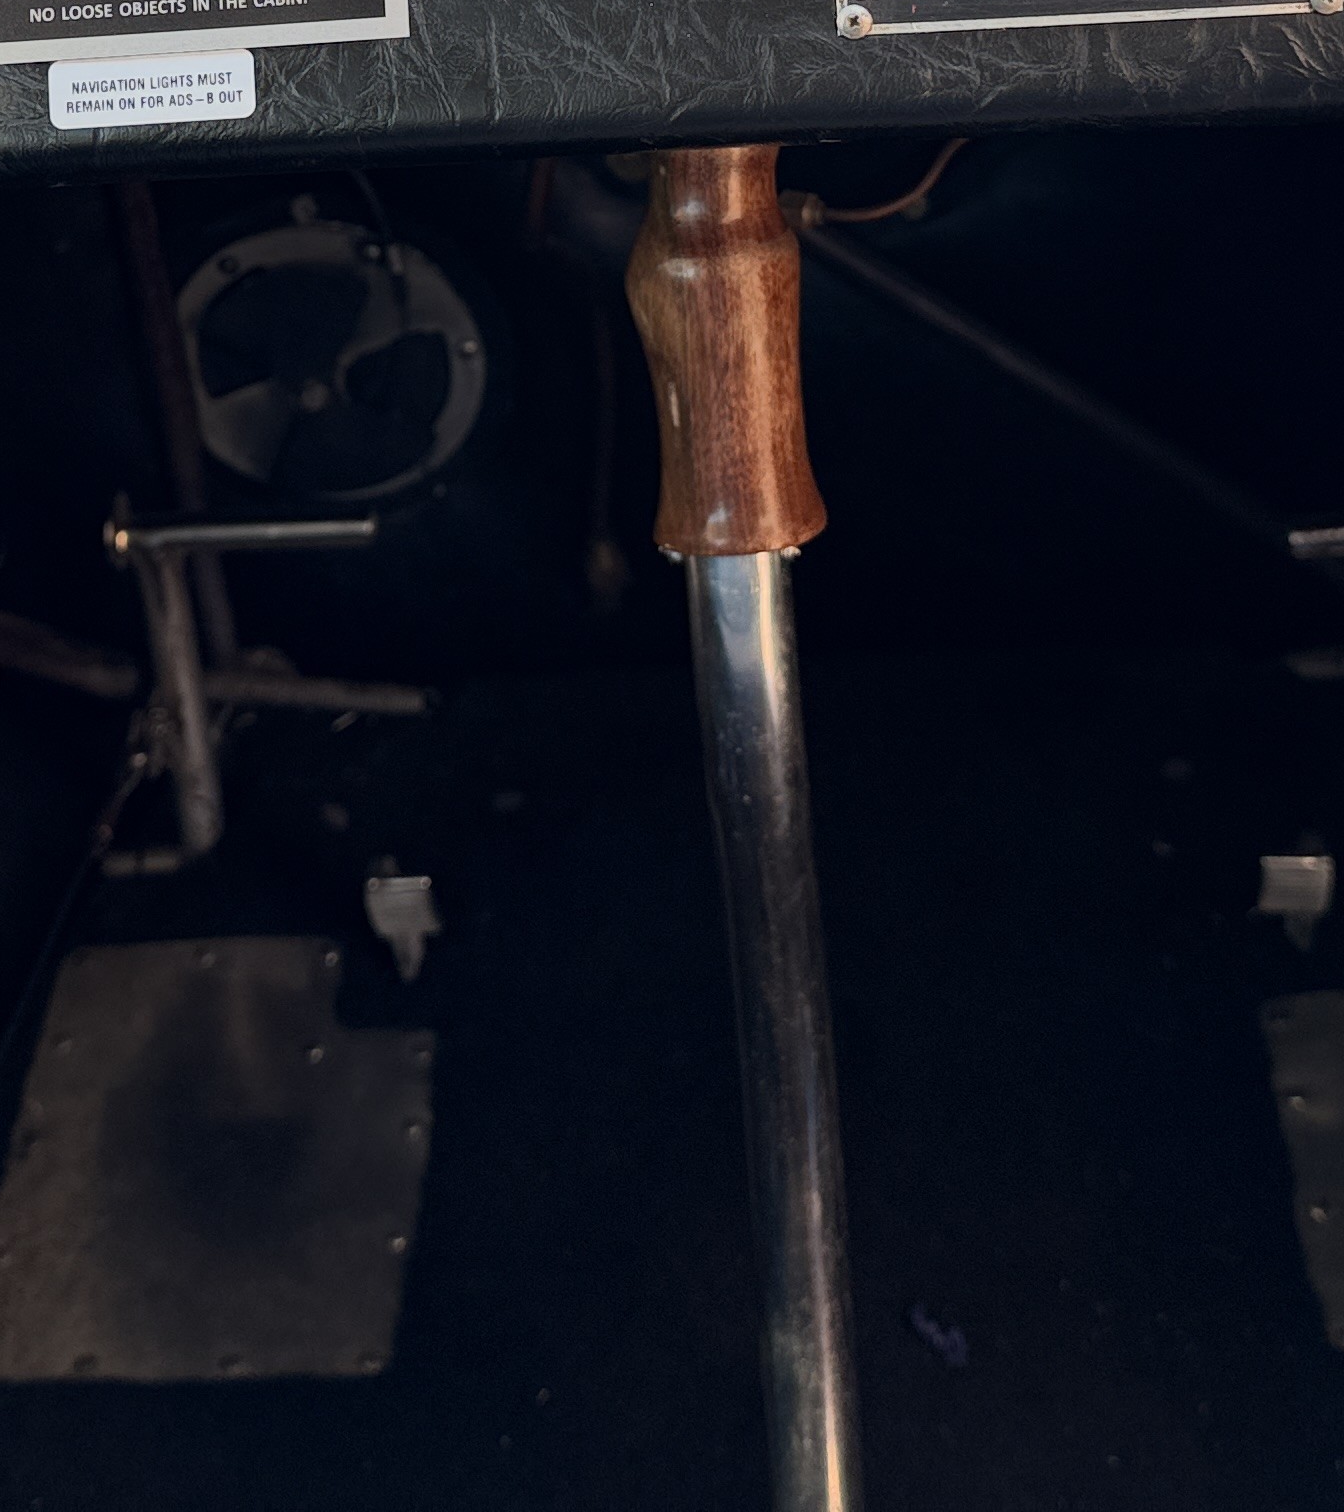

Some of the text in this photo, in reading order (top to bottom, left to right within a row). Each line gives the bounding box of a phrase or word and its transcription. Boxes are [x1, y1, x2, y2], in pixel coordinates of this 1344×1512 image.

[29, 6, 56, 24] NO
[61, 2, 114, 22] LOOSE
[71, 71, 232, 95] NAVIGATION LIGHTS MUST
[66, 89, 242, 114] REMAIN ON FOR OUT
